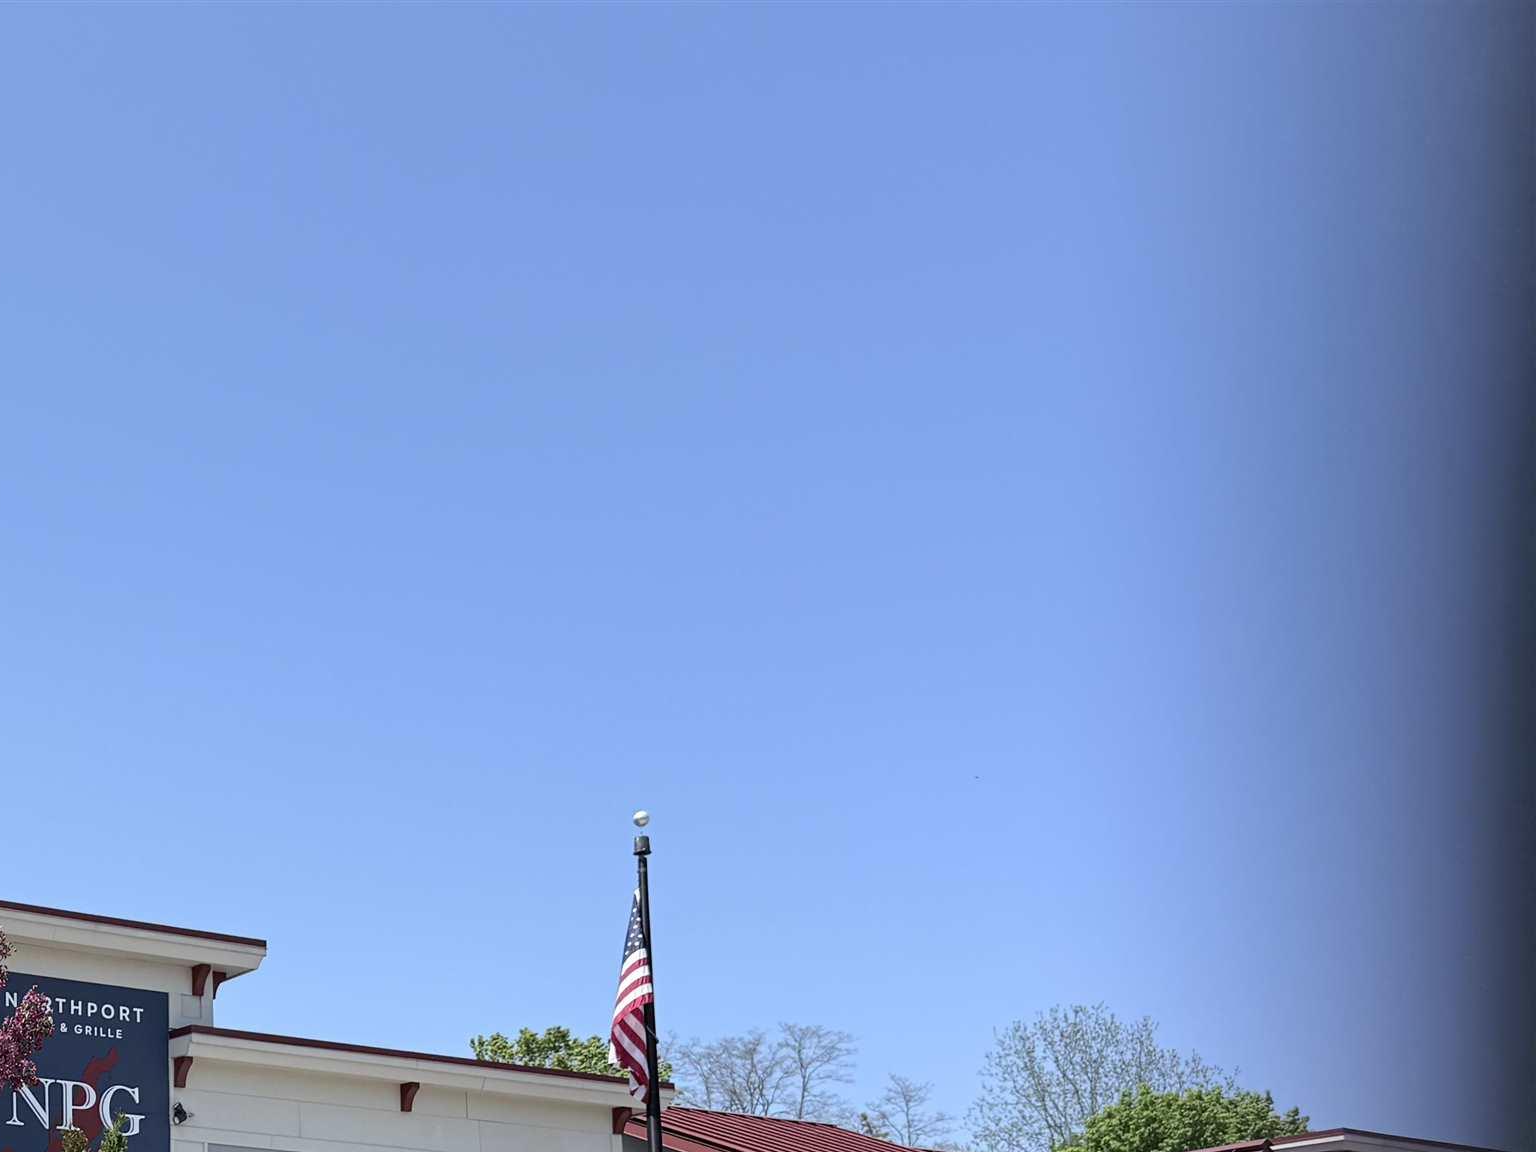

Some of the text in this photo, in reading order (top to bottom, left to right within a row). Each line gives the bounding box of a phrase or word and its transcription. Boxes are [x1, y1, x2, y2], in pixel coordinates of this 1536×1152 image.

[5, 991, 144, 1023] NRTHPORT
[60, 1022, 123, 1039] & GRILLE
[5, 1078, 145, 1137] NPG
